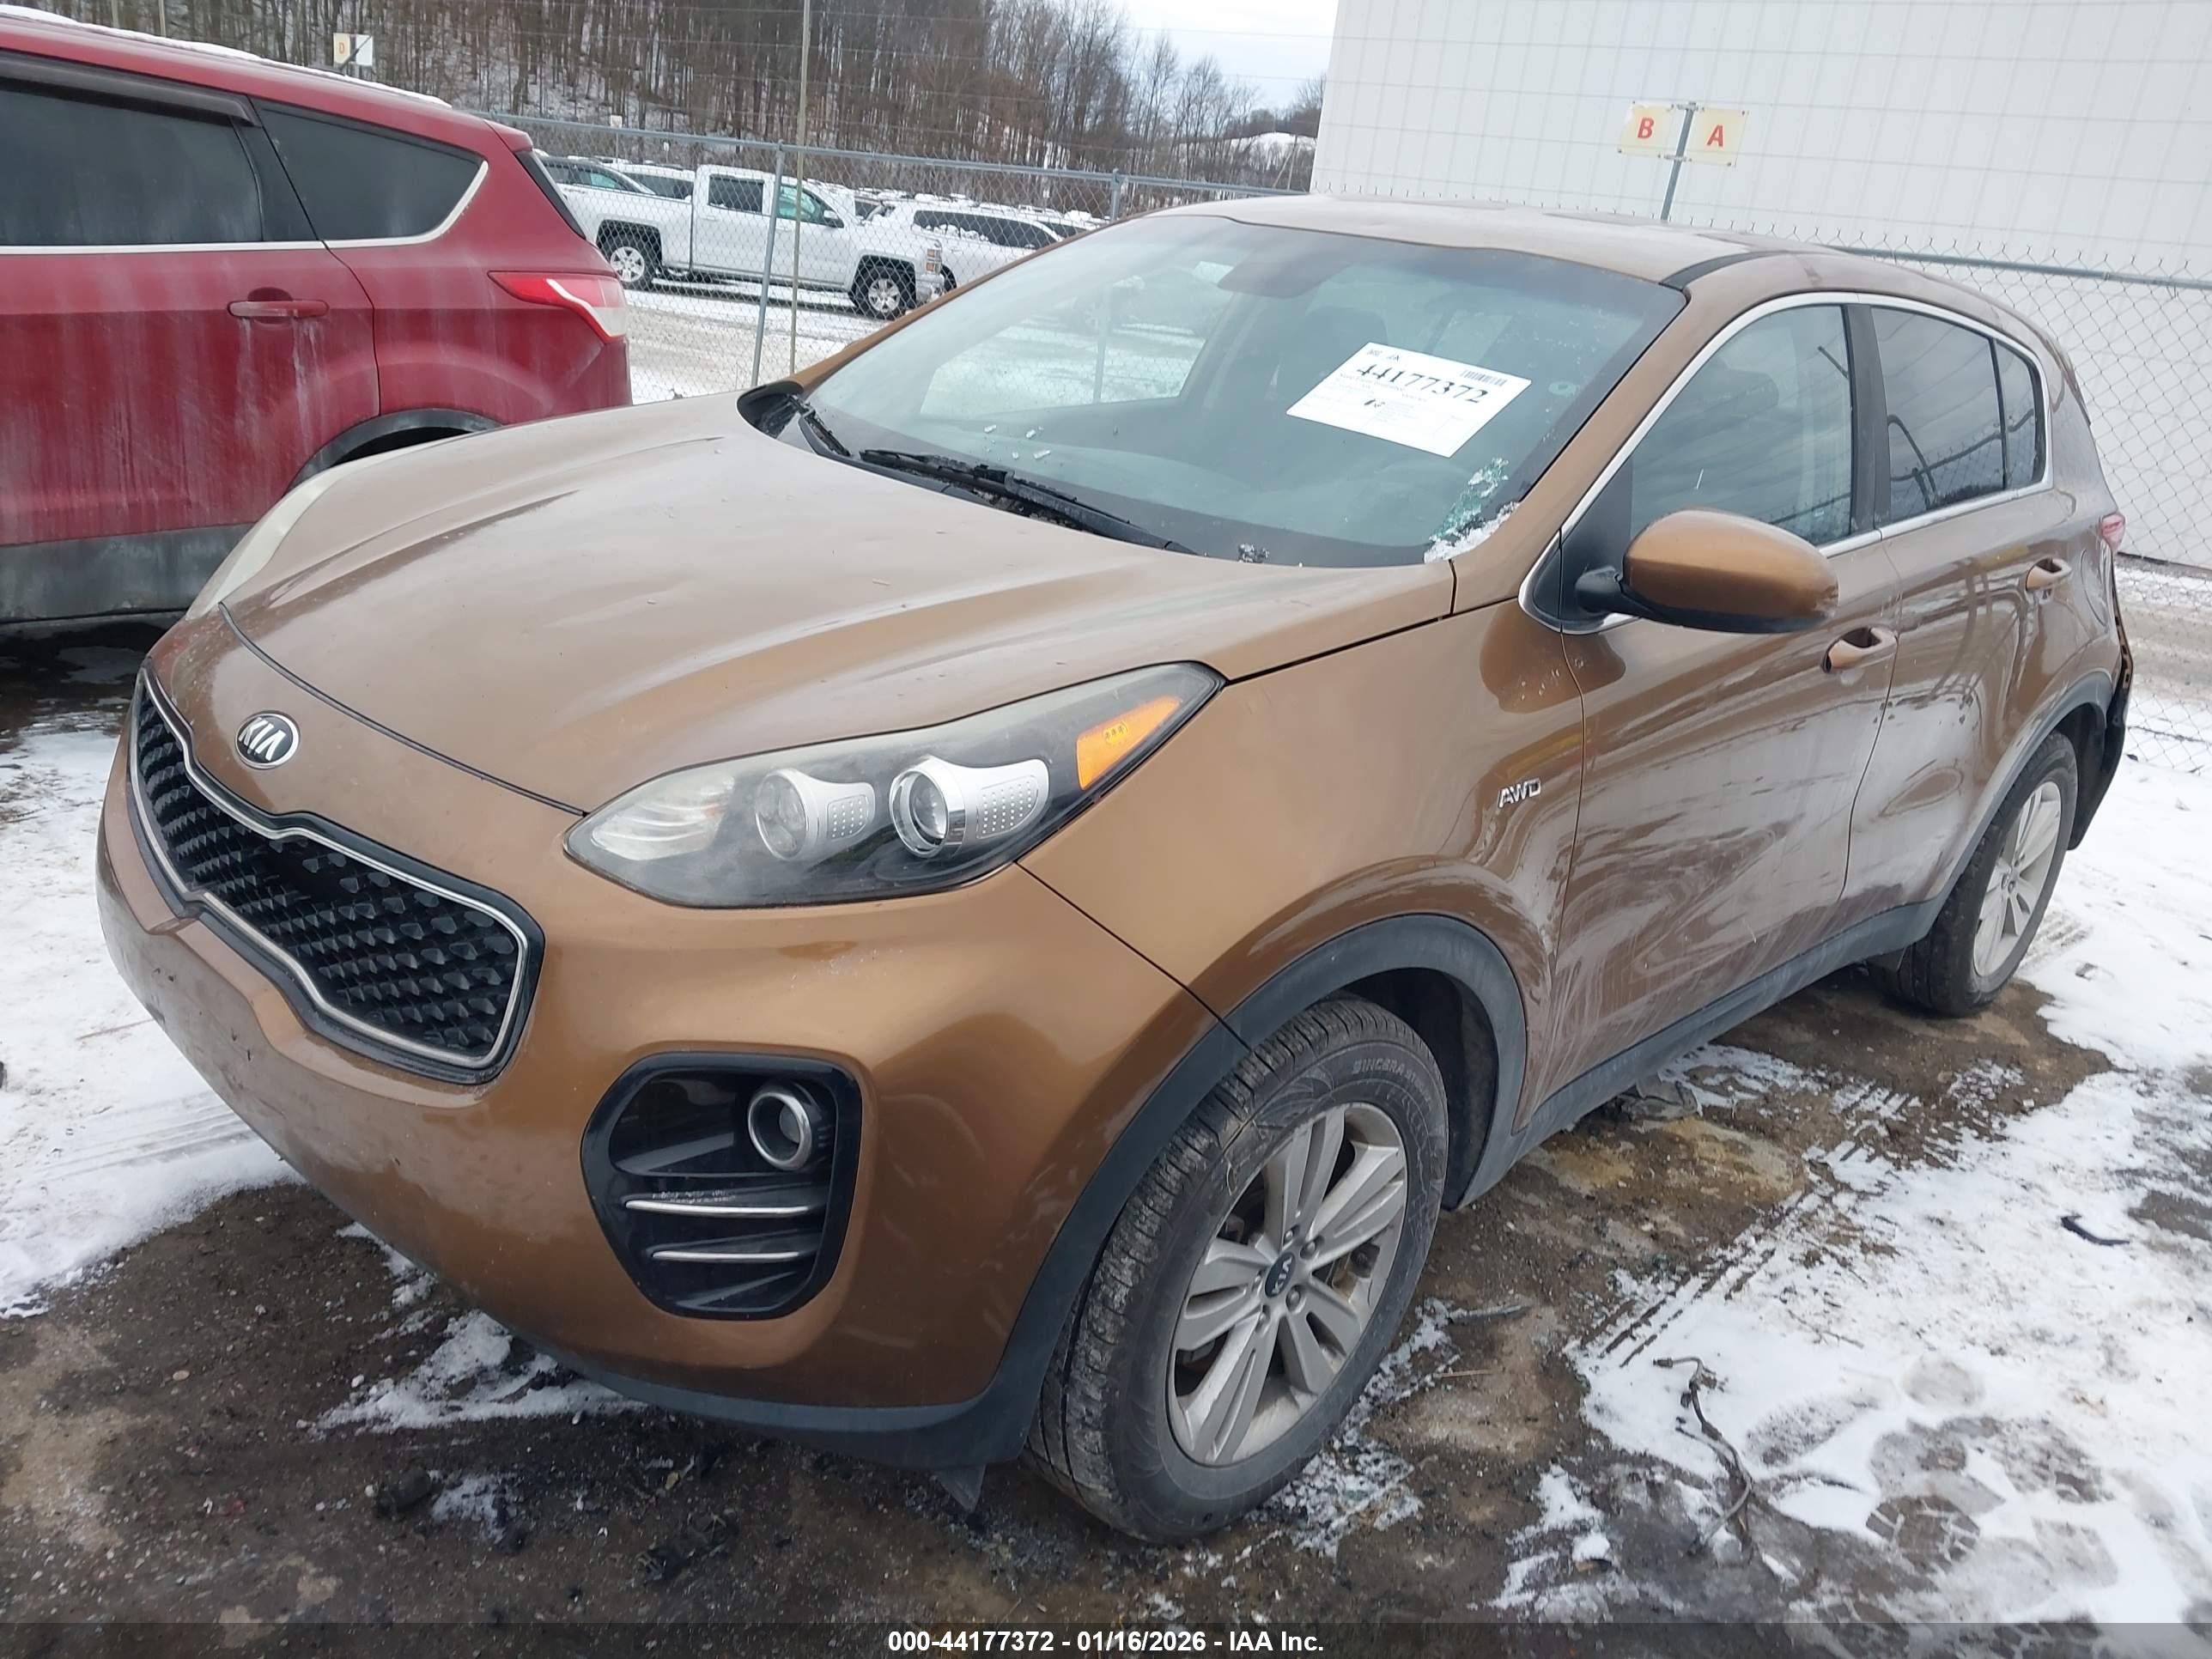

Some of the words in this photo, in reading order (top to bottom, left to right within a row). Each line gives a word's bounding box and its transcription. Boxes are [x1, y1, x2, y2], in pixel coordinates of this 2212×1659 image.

[1637, 117, 1655, 139] B
[1706, 124, 1723, 147] A
[1357, 364, 1488, 404] 44177372
[239, 716, 287, 761] KIA
[1498, 778, 1541, 808] AWD
